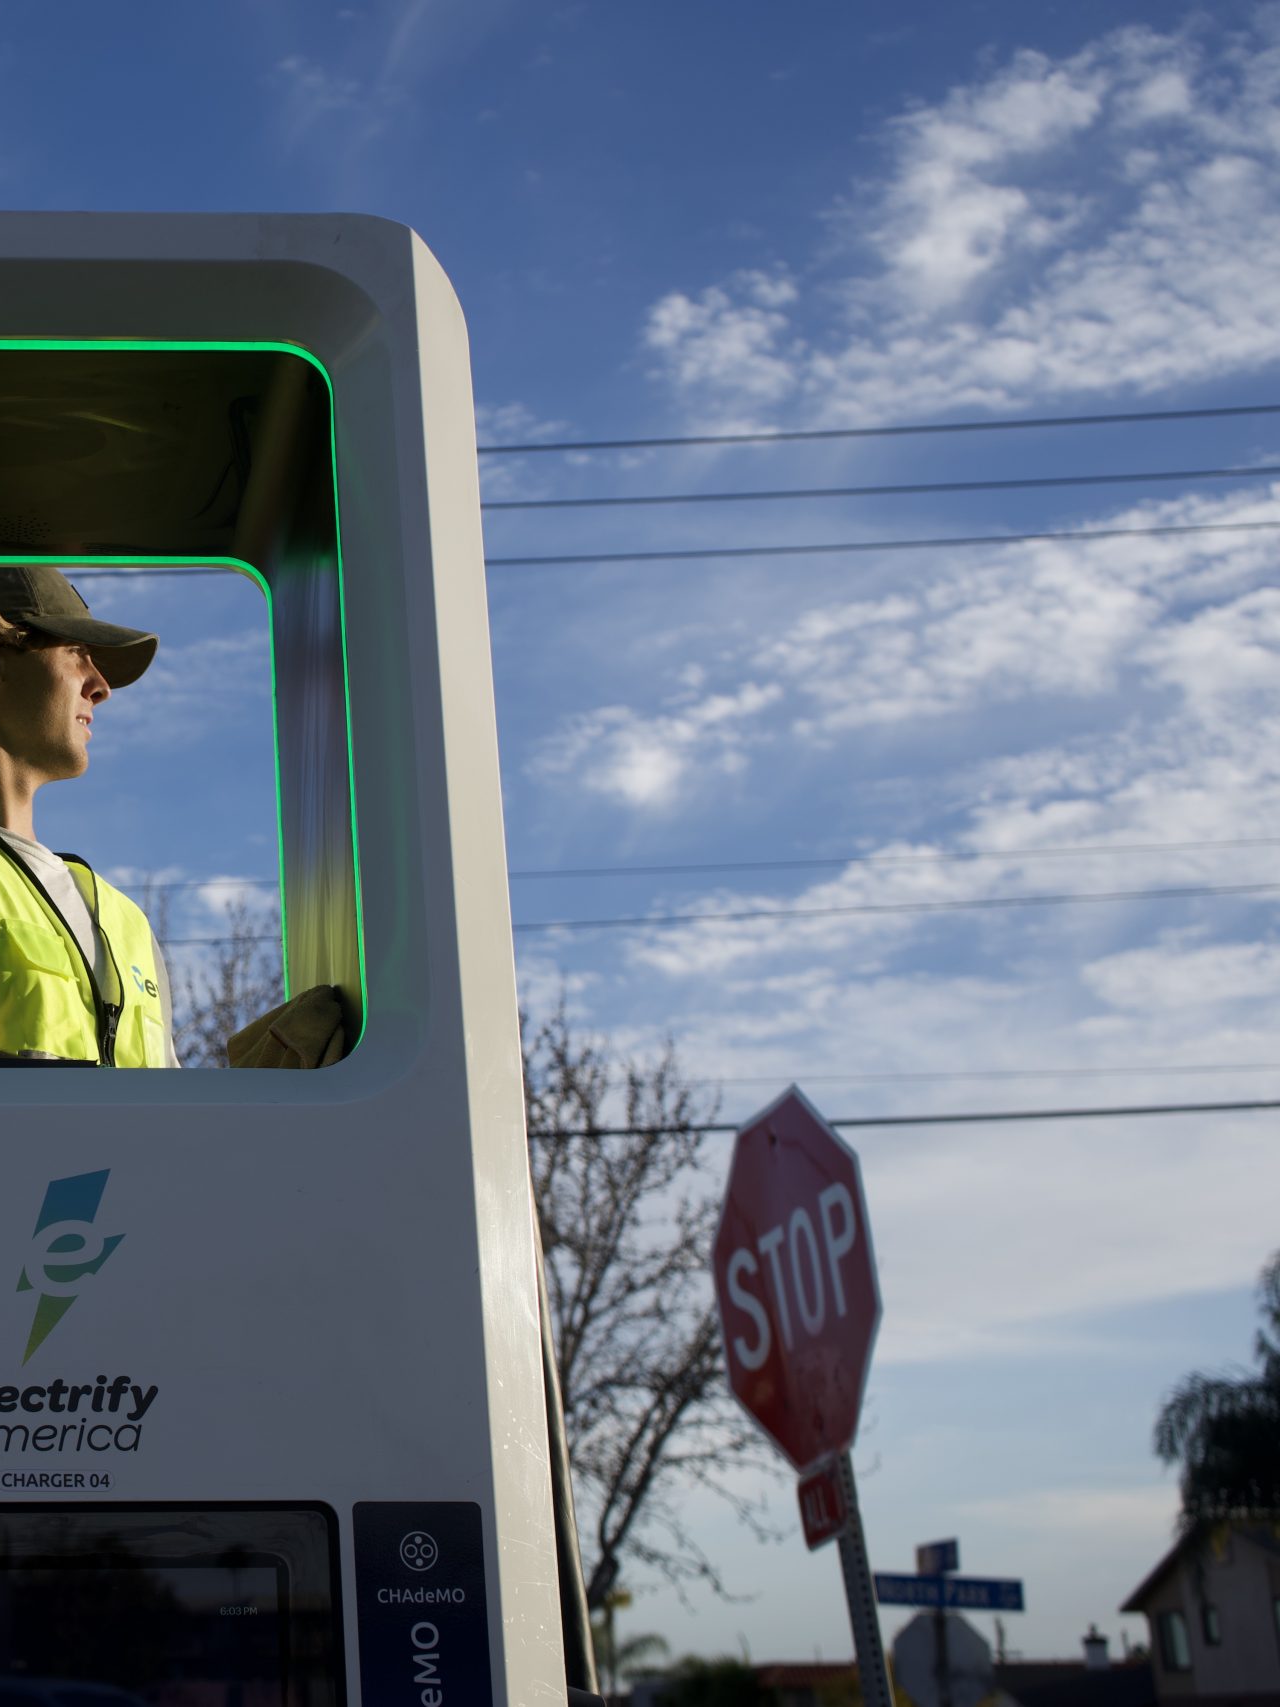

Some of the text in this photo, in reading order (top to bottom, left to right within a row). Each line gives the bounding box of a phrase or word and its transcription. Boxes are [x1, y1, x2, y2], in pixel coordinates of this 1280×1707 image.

[726, 1181, 857, 1371] STOP
[1, 1472, 111, 1488] CHARGER 04
[377, 1586, 466, 1604] CHAdeMO
[220, 1606, 258, 1616] 6:03 PM
